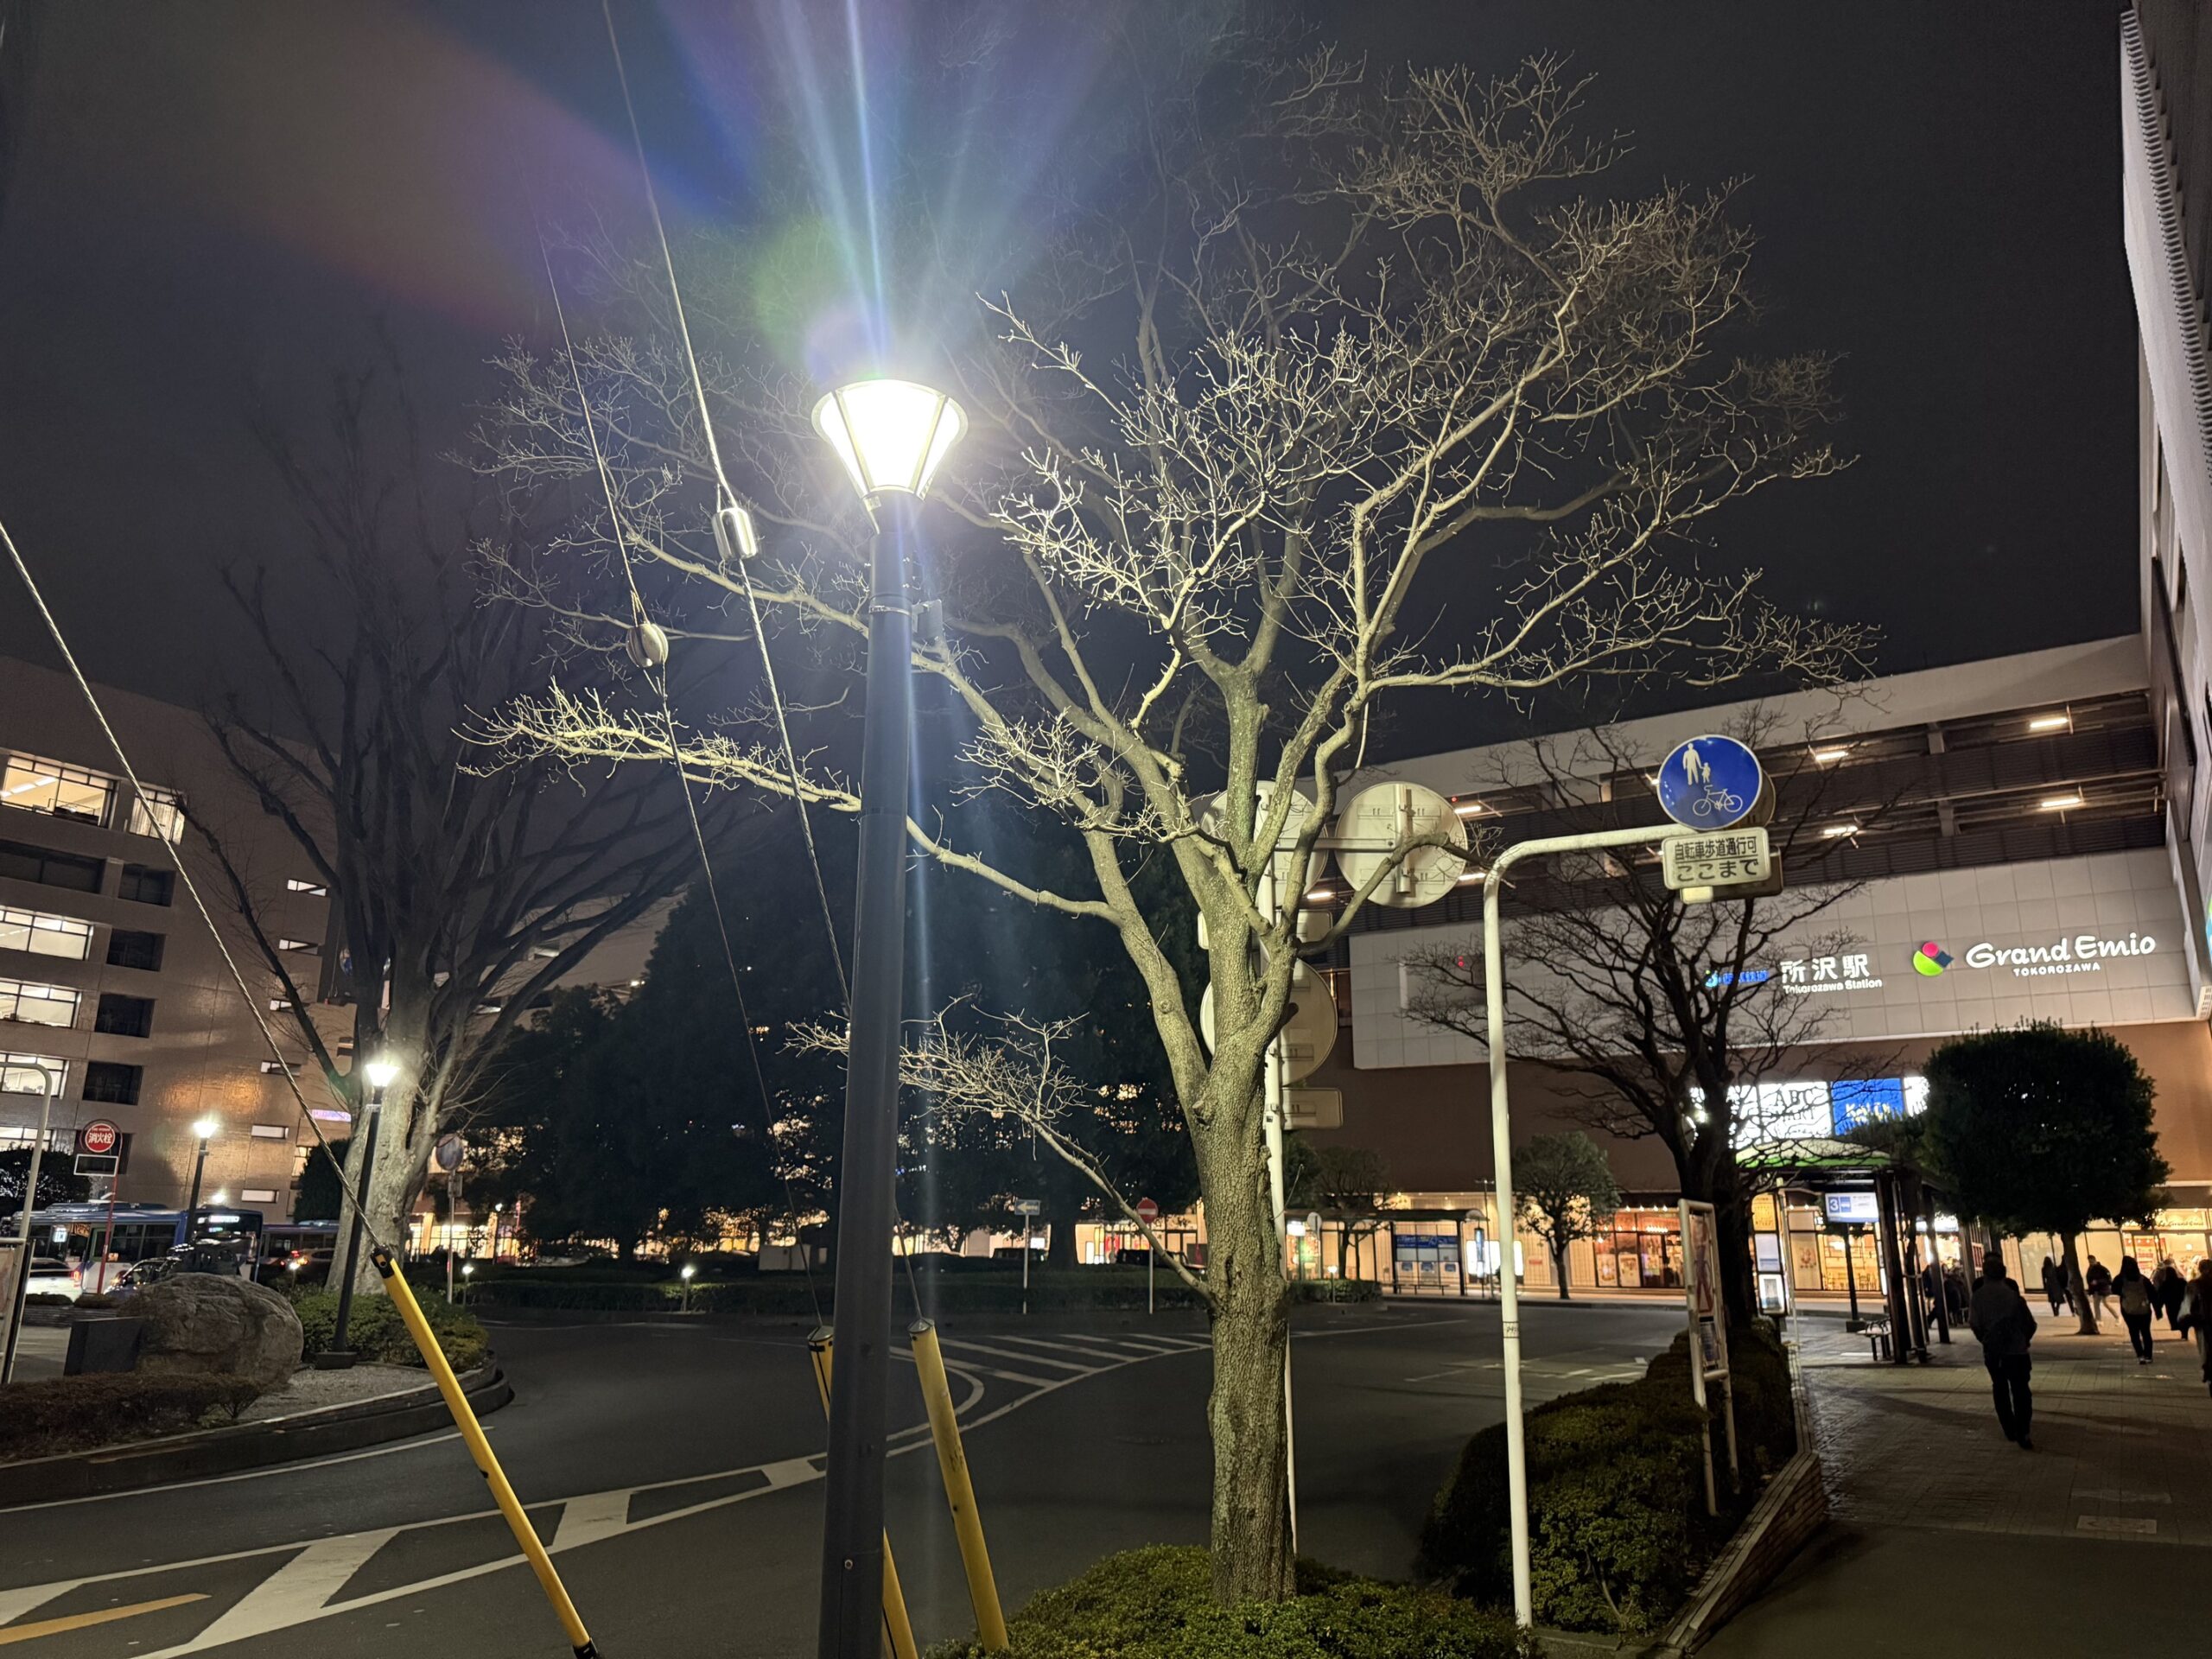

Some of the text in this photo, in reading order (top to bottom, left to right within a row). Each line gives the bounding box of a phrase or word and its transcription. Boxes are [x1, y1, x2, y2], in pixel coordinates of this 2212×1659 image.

[1675, 836, 1758, 861] 自転車歩道通行可
[1676, 859, 1759, 882] ここまで
[1966, 932, 2156, 969] Grand Emio
[1780, 954, 1870, 984] 所沢駅
[2013, 962, 2101, 977] TOKOROZAWA
[1783, 978, 1883, 995] Tokorozawa Station
[88, 1132, 112, 1144] 消火栓
[1829, 1198, 1839, 1211] 3
